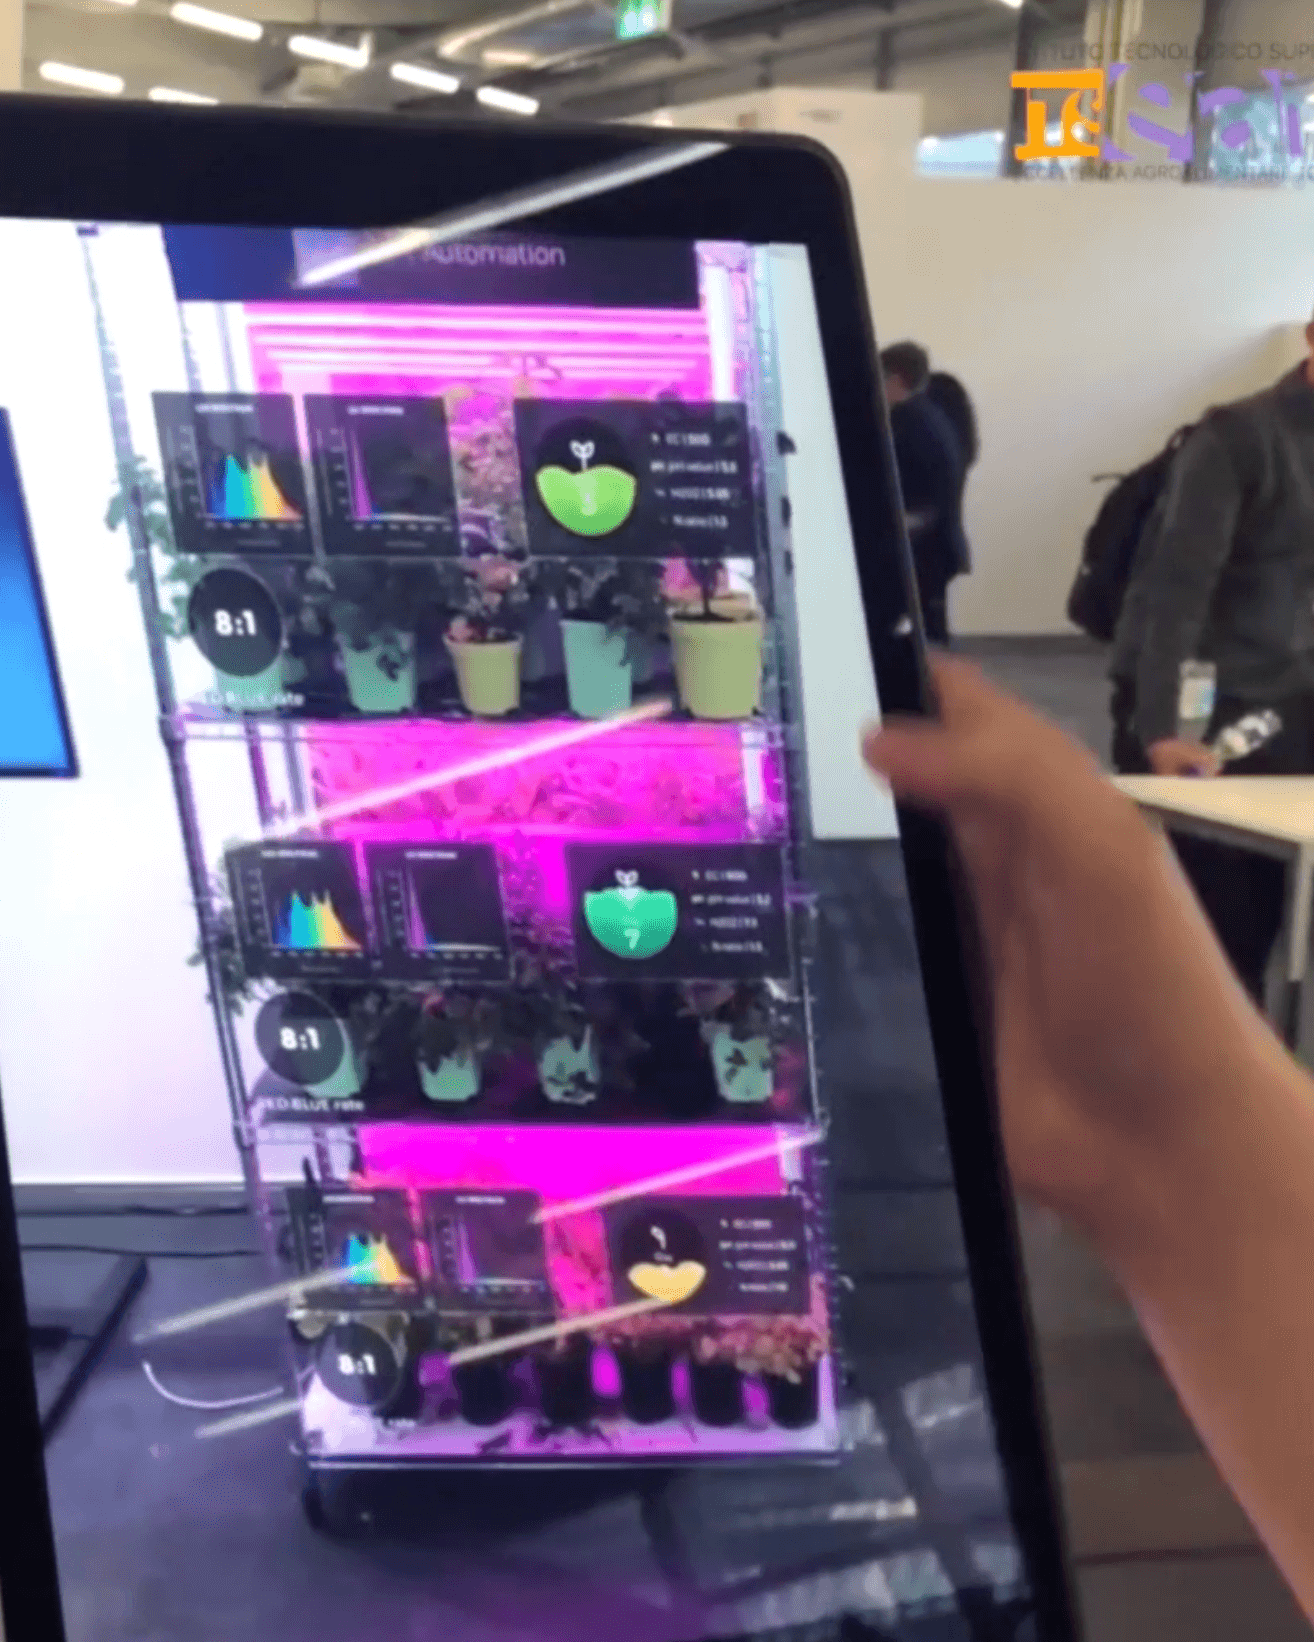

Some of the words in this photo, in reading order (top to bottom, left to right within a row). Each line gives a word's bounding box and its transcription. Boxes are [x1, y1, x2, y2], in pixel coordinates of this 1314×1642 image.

[214, 609, 256, 636] 8:1
[279, 1027, 321, 1050] 8:1
[337, 1354, 376, 1375] 8:1
